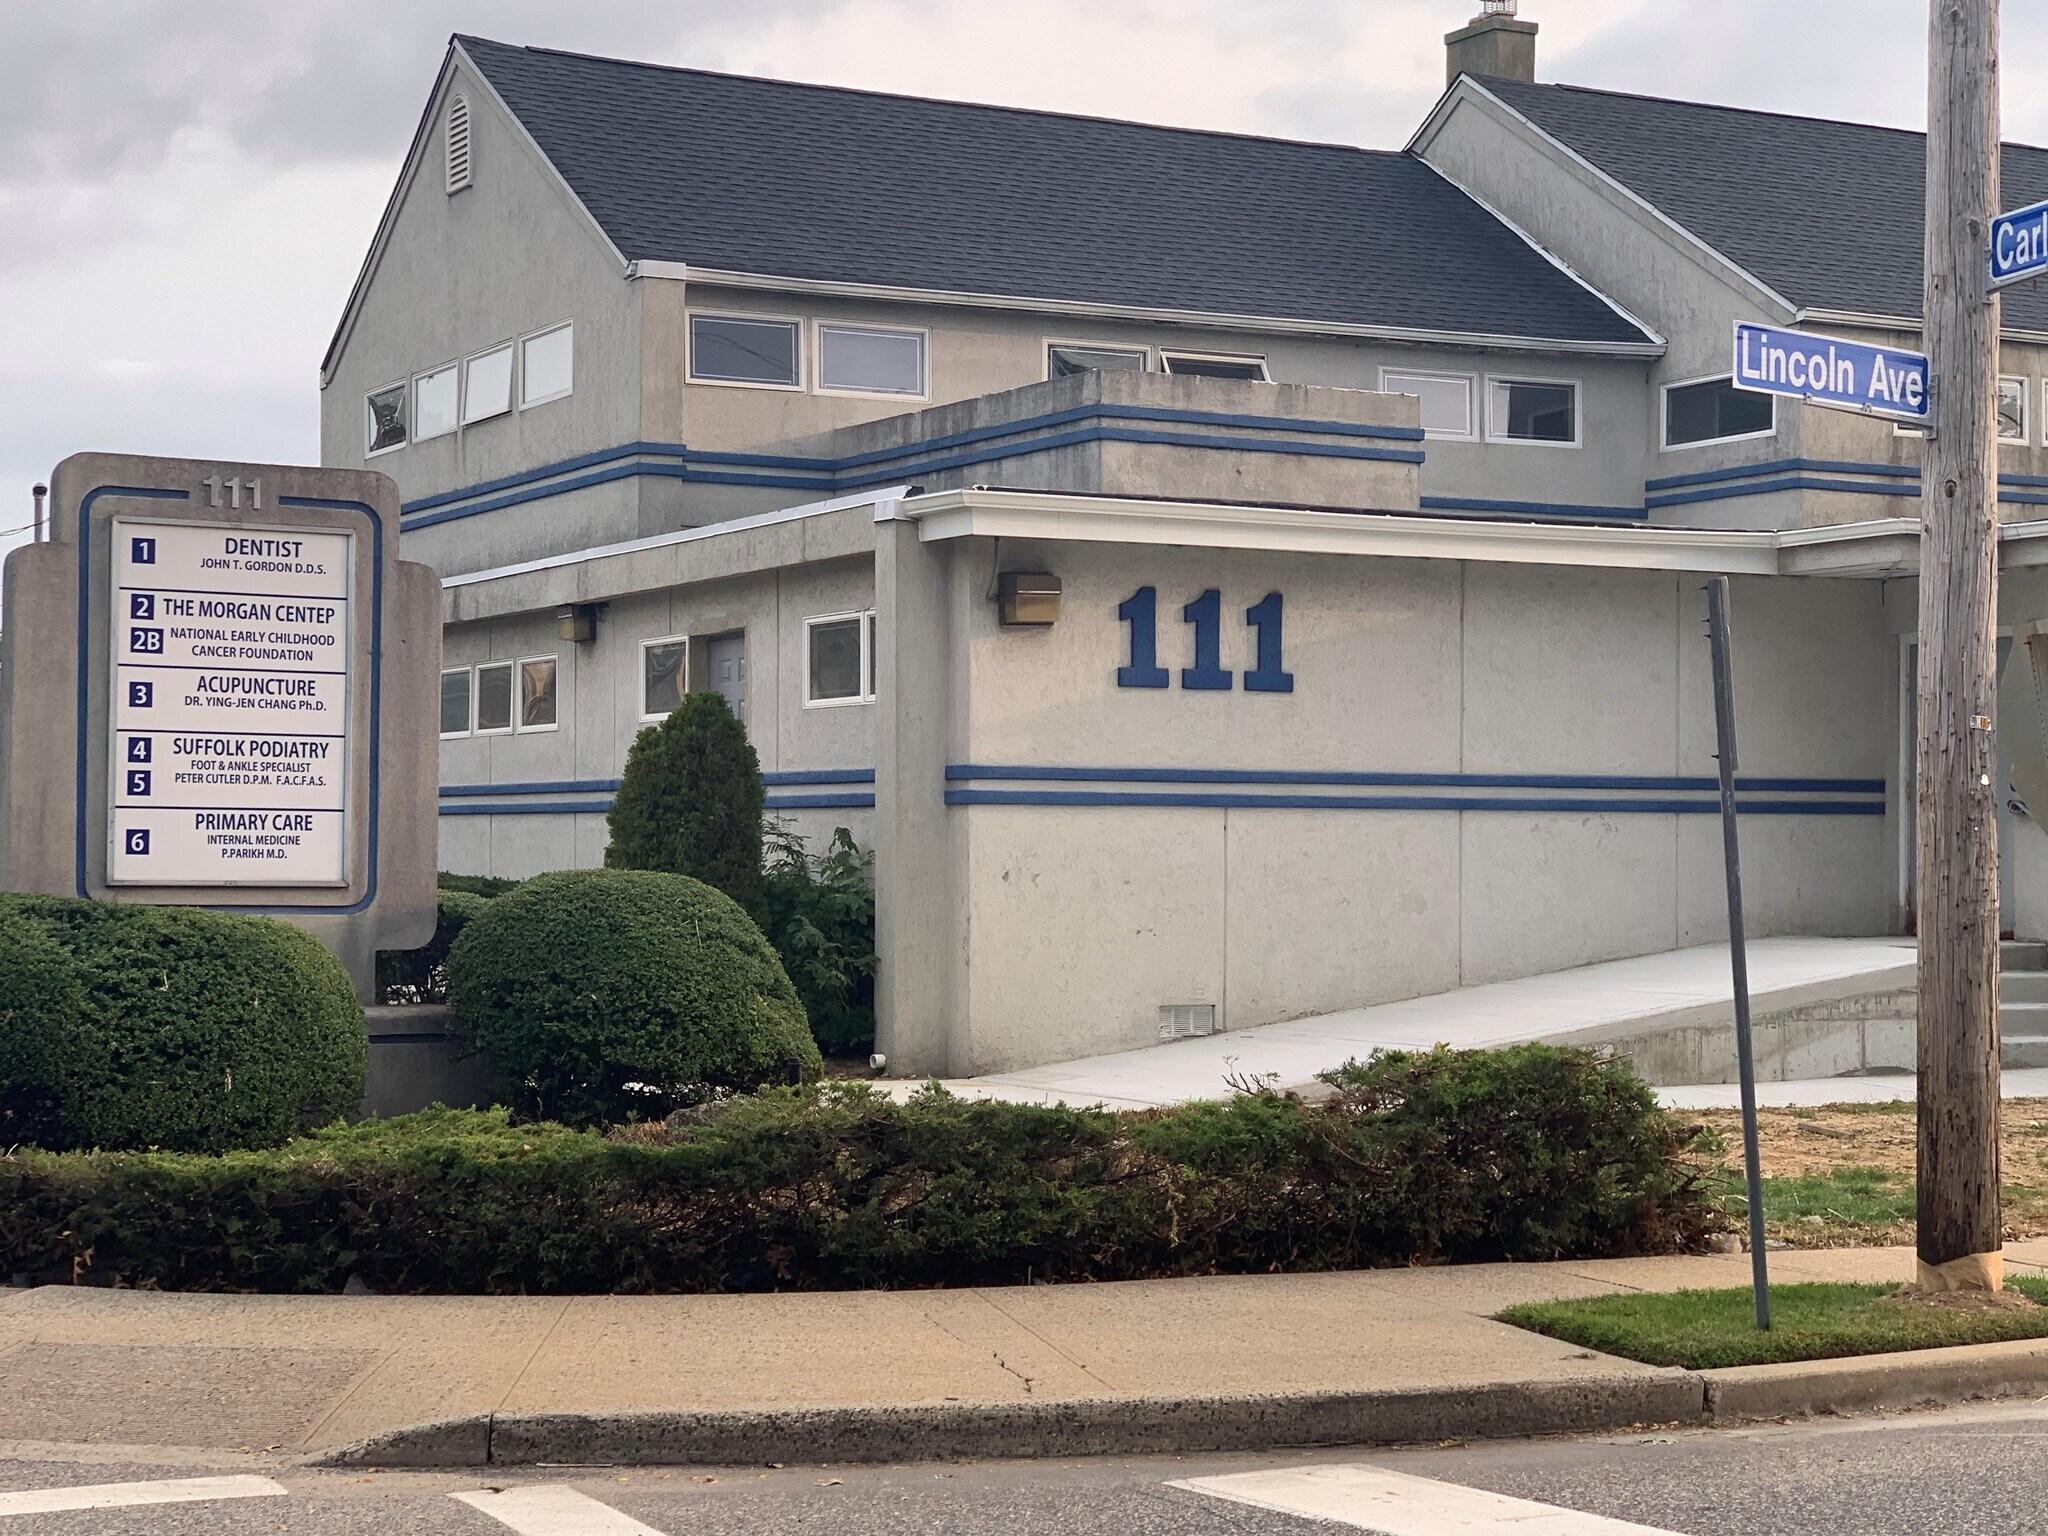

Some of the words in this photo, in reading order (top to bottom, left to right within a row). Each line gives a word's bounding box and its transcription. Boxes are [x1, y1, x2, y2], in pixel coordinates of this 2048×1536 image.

[1742, 331, 1854, 395] Lincoln
[1868, 354, 1923, 406] Ave
[202, 475, 260, 510] 111
[139, 542, 148, 560] 1
[225, 538, 302, 558] DENTIST
[200, 558, 230, 569] JOHN
[232, 560, 242, 570] T.
[245, 561, 292, 573] GORDON
[295, 564, 326, 574] D.D.S.
[136, 598, 148, 616] 2
[163, 598, 194, 616] THE
[198, 601, 271, 621] MORGAN
[134, 632, 160, 650] 2B
[170, 628, 228, 641] NATIONAL
[231, 630, 266, 643] EARLY
[268, 632, 334, 646] CHILDHOOD
[1118, 586, 1293, 692] 111
[192, 646, 236, 658] CANCER
[239, 648, 313, 661] FOUNDATION
[134, 686, 147, 704] 3
[197, 676, 316, 696] ACUPUNCTURE
[184, 696, 203, 706] DR.
[206, 696, 255, 708] YING-JEN
[258, 698, 296, 710] CHANG
[299, 700, 326, 711] Ph.D.
[133, 741, 146, 759] 4
[173, 738, 245, 756] SUFFOLK
[250, 740, 329, 759] PODIATRY
[191, 760, 216, 770] FOOT
[218, 762, 225, 770] &
[228, 761, 258, 772] ANKLE
[260, 762, 311, 772] SPECIALIST
[133, 774, 145, 792] 5
[175, 773, 204, 783] PETER
[206, 774, 240, 784] CUTLER
[243, 775, 272, 785] D.P.M.
[276, 776, 326, 786] F.A.C.F.A.S.
[195, 814, 268, 830] PRIMARY
[272, 814, 313, 831] CARE
[131, 834, 144, 850] 6
[208, 835, 253, 844] INTERNAL
[256, 836, 300, 845] MEDICINE
[222, 848, 264, 858] P.PARIKH
[267, 850, 287, 858] M.D.
